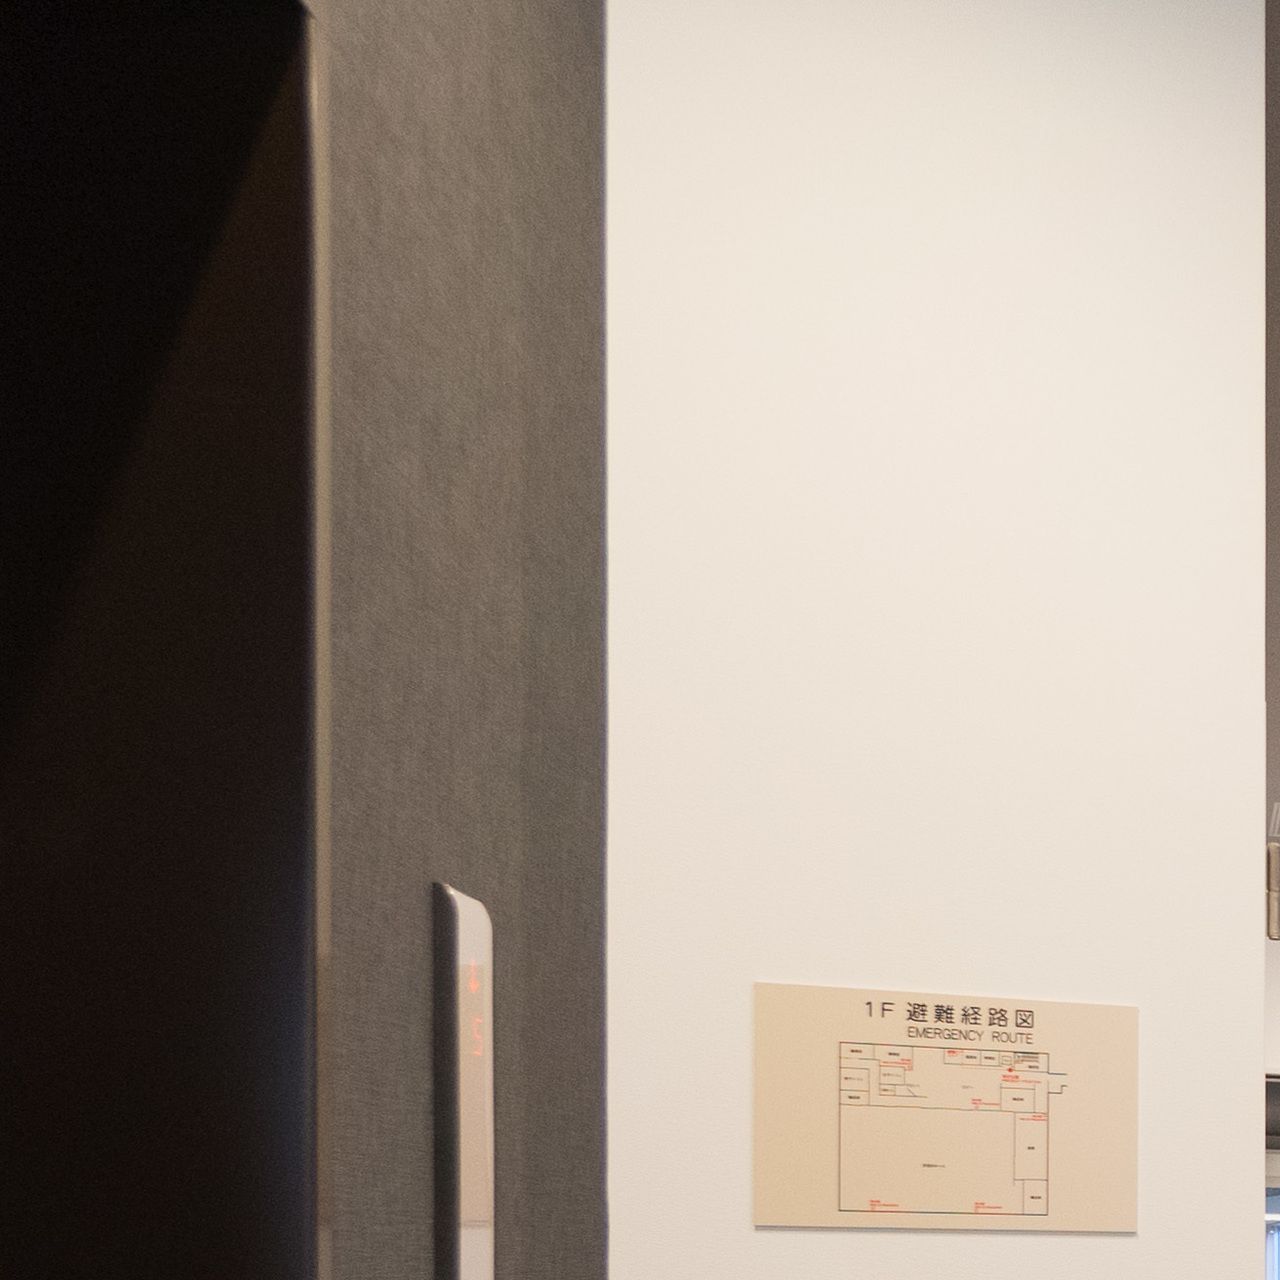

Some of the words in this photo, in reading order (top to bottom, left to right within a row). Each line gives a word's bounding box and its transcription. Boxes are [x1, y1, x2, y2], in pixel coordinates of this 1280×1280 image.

[865, 1001, 895, 1018] 1F
[906, 1002, 1034, 1029] 避難経路図
[907, 1026, 985, 1043] EMERGENCY
[991, 1031, 1034, 1046] ROUTE
